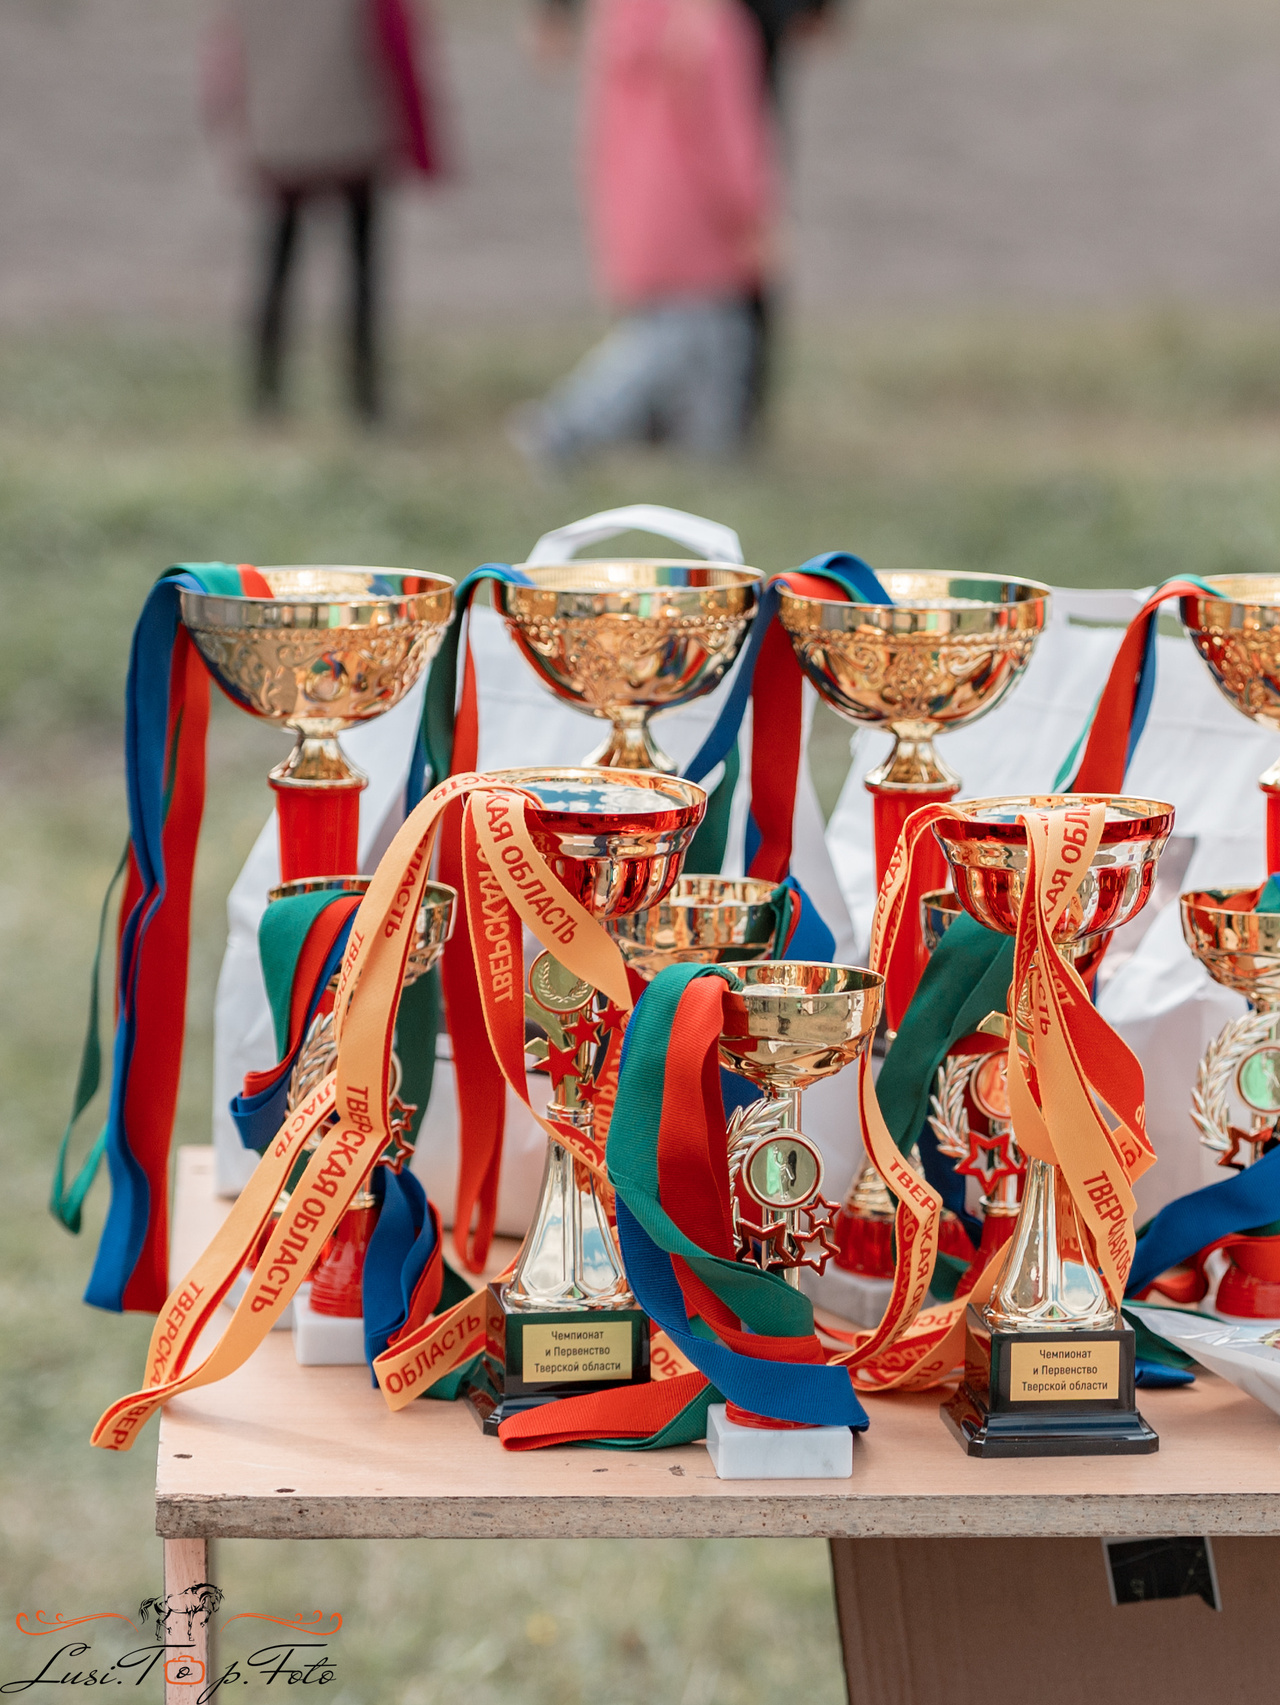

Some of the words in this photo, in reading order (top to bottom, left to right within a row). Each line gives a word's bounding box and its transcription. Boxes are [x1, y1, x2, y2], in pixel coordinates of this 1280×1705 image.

[501, 845, 579, 944] ОБЛАСТЬ
[310, 1086, 374, 1199] ТВЕРСКАЯ
[889, 1157, 938, 1281] ТВЕРСКАЯ
[250, 1197, 326, 1313] ОБЛАСТЬ
[551, 1330, 605, 1340] Чемпионат
[385, 1314, 481, 1395] ОБЛАСТЬ
[545, 1349, 551, 1357] и
[553, 1346, 611, 1358] Первенство
[1039, 1349, 1092, 1359] Чемпионат
[534, 1362, 579, 1374] Тверской
[582, 1360, 621, 1371] области
[1032, 1367, 1039, 1375] и
[1041, 1364, 1098, 1377] Первенство
[1022, 1380, 1067, 1393] Тверской
[1069, 1380, 1108, 1391] области
